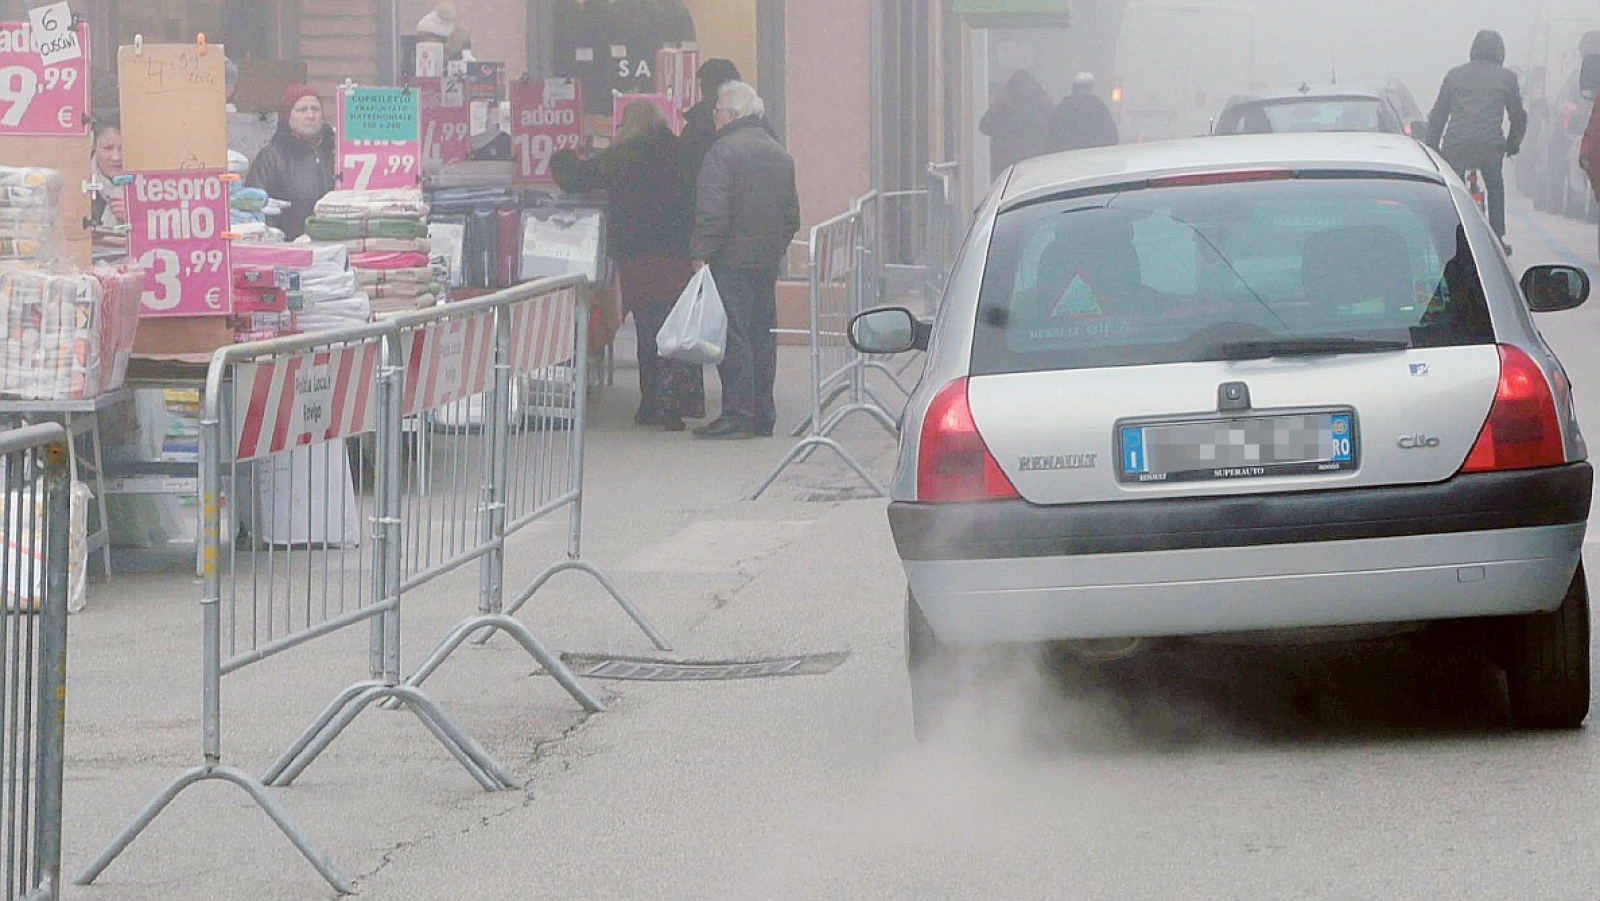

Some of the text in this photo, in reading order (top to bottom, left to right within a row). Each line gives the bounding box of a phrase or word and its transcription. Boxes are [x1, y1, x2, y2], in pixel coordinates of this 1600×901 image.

[42, 8, 58, 31] 6
[58, 105, 73, 128] €
[521, 103, 576, 126] adoro
[344, 153, 415, 190] 7,99
[135, 173, 221, 202] tesoro
[146, 200, 215, 240] mio
[140, 248, 223, 311] 3,99 €
[1332, 438, 1350, 456] RO
[1397, 431, 1441, 450] Clio
[1018, 453, 1099, 471] RENAULT
[1214, 467, 1265, 478] SUPERAUTO
